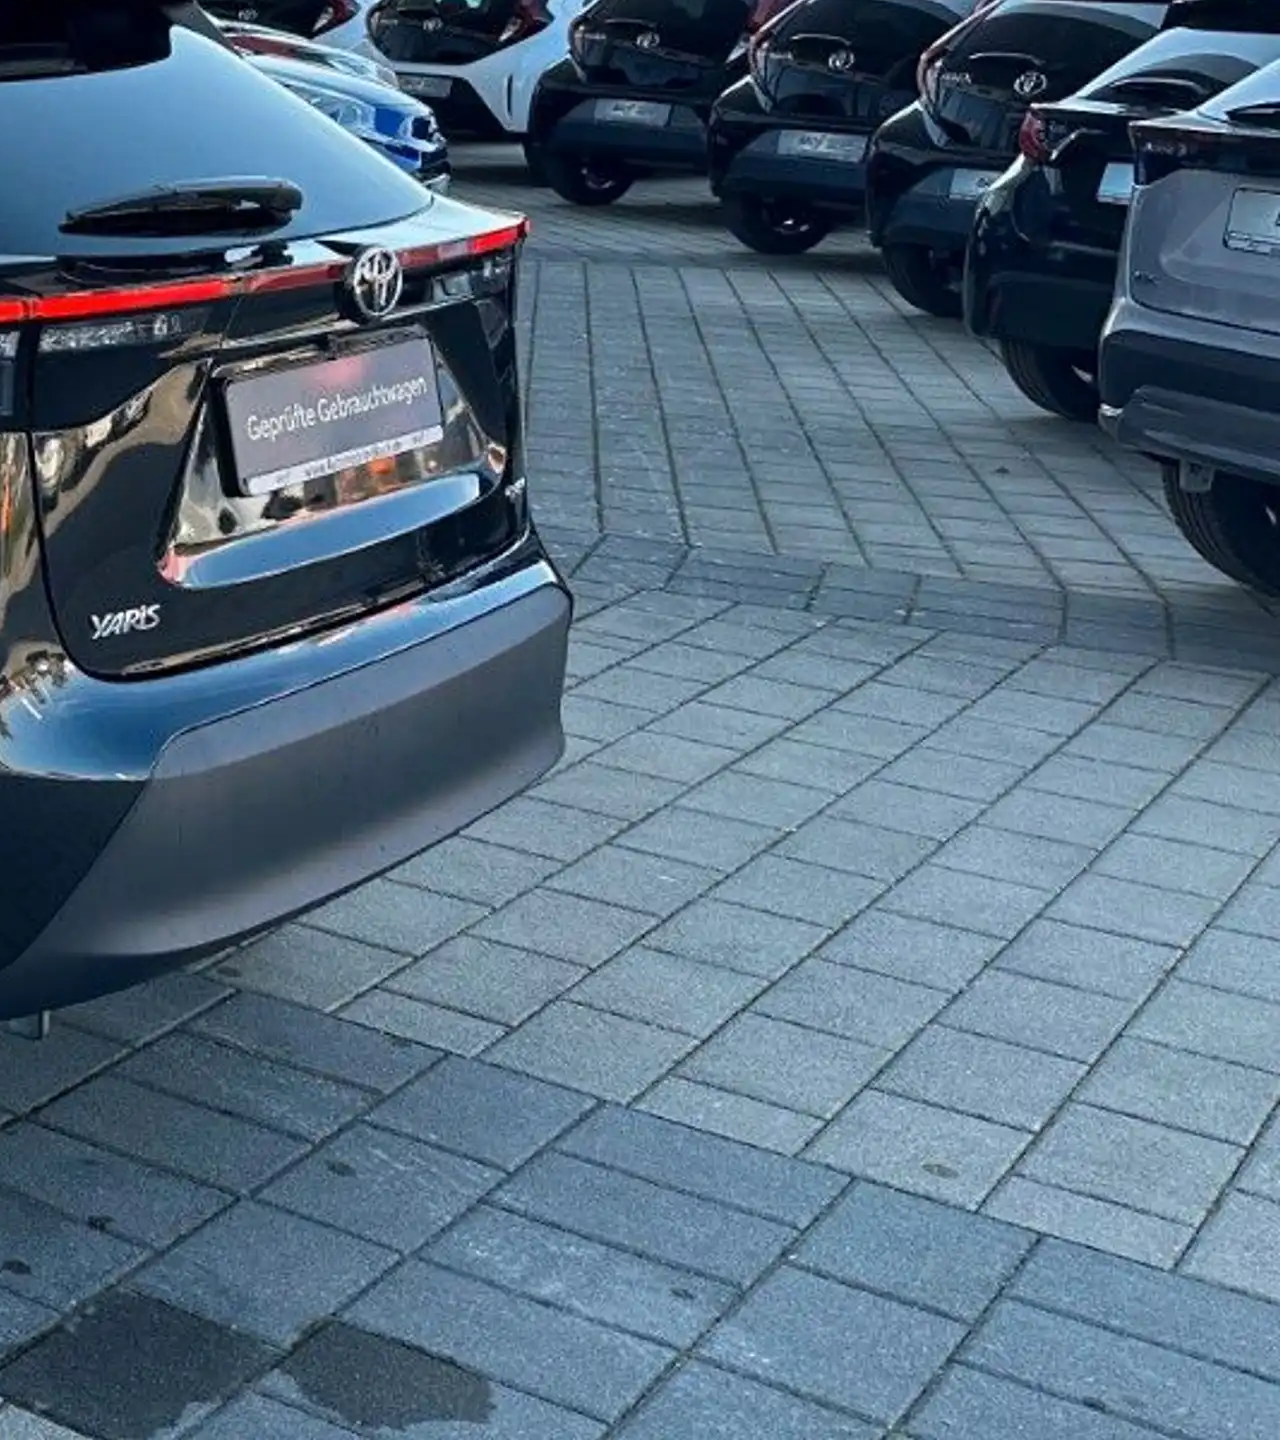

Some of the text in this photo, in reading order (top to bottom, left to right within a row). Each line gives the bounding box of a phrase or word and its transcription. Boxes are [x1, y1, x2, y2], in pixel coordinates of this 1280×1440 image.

[246, 375, 428, 442] Geprüfte Gebrauchtwagen
[90, 603, 162, 641] YARIS
